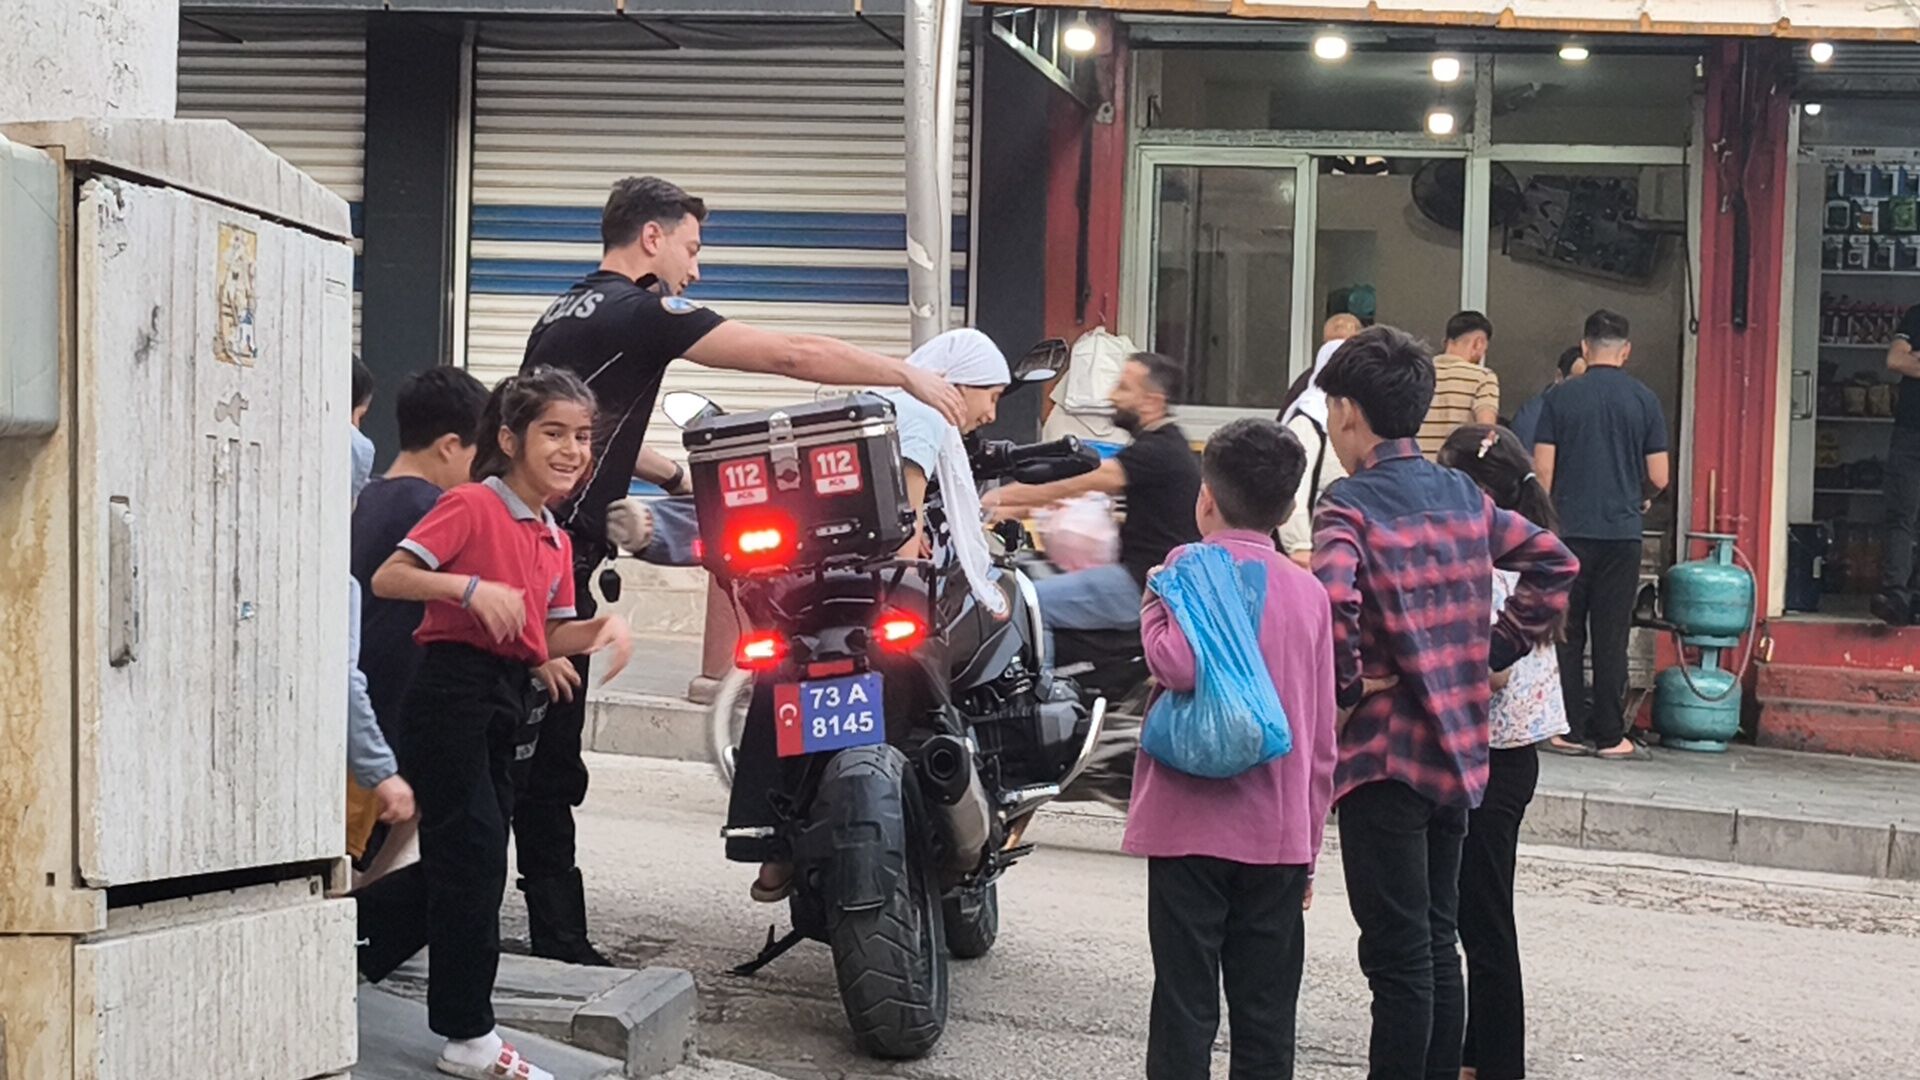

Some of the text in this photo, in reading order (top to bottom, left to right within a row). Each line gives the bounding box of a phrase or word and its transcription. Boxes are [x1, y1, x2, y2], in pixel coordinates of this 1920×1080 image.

[725, 463, 762, 489] 112
[817, 450, 854, 476] 112
[809, 683, 869, 709] 73 A
[812, 711, 874, 738] 8145
